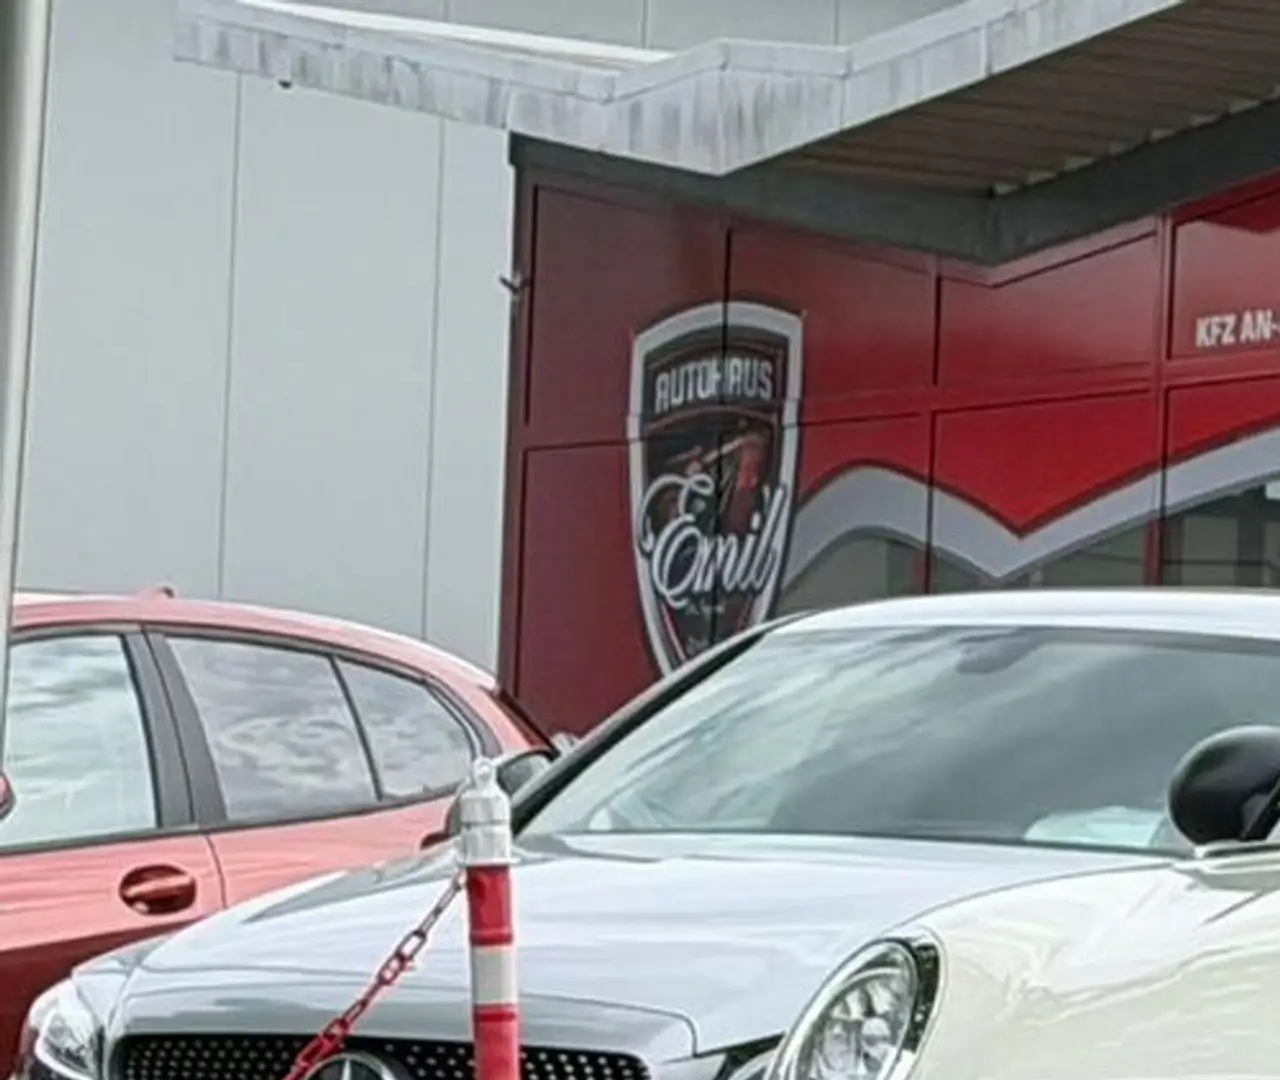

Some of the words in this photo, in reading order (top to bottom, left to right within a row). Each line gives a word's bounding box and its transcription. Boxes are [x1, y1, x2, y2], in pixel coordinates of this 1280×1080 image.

[1196, 314, 1237, 348] KFZ
[655, 356, 774, 414] AUTOHAUS
[638, 473, 787, 608] Emil
